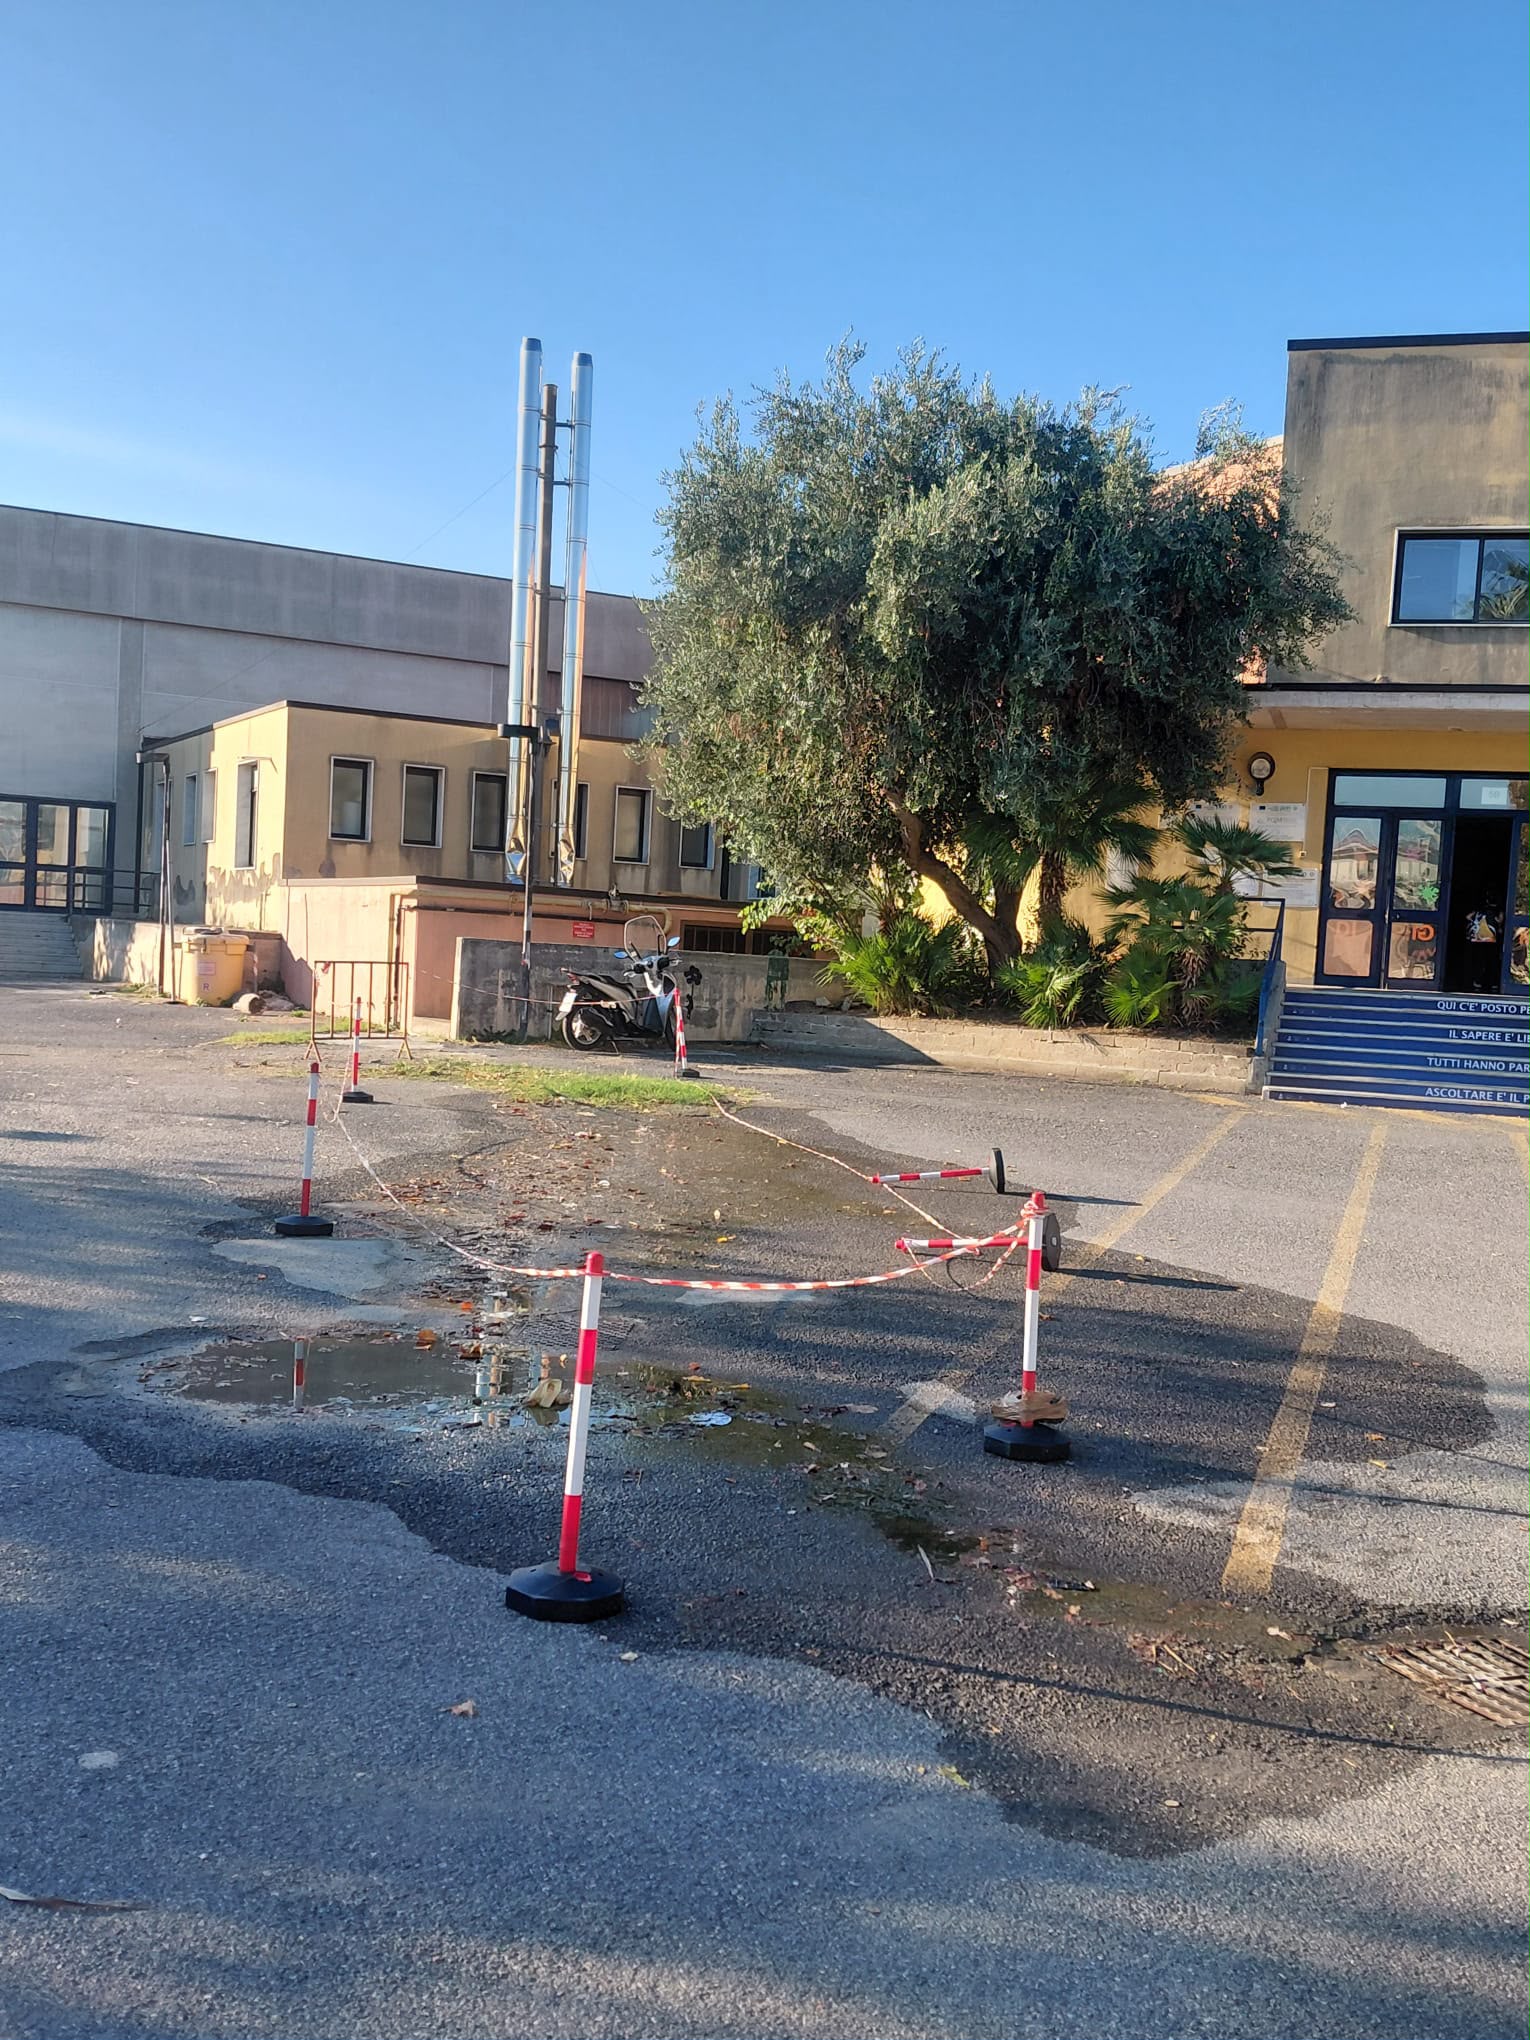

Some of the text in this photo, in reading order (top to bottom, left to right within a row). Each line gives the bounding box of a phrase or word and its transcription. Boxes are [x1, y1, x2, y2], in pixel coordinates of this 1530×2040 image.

[1437, 1001, 1456, 1011] QUI
[1459, 1002, 1478, 1011] C'E'
[1481, 1004, 1517, 1013] POSTO
[1449, 1030, 1458, 1039] IL
[1461, 1031, 1501, 1040] SAPERE
[1505, 1033, 1514, 1042] E'
[1427, 1057, 1530, 1072] TUTTI HANNO PAR
[1425, 1088, 1493, 1100] ASCOLTARE
[1497, 1092, 1506, 1101] E'
[1509, 1093, 1520, 1103] IL
